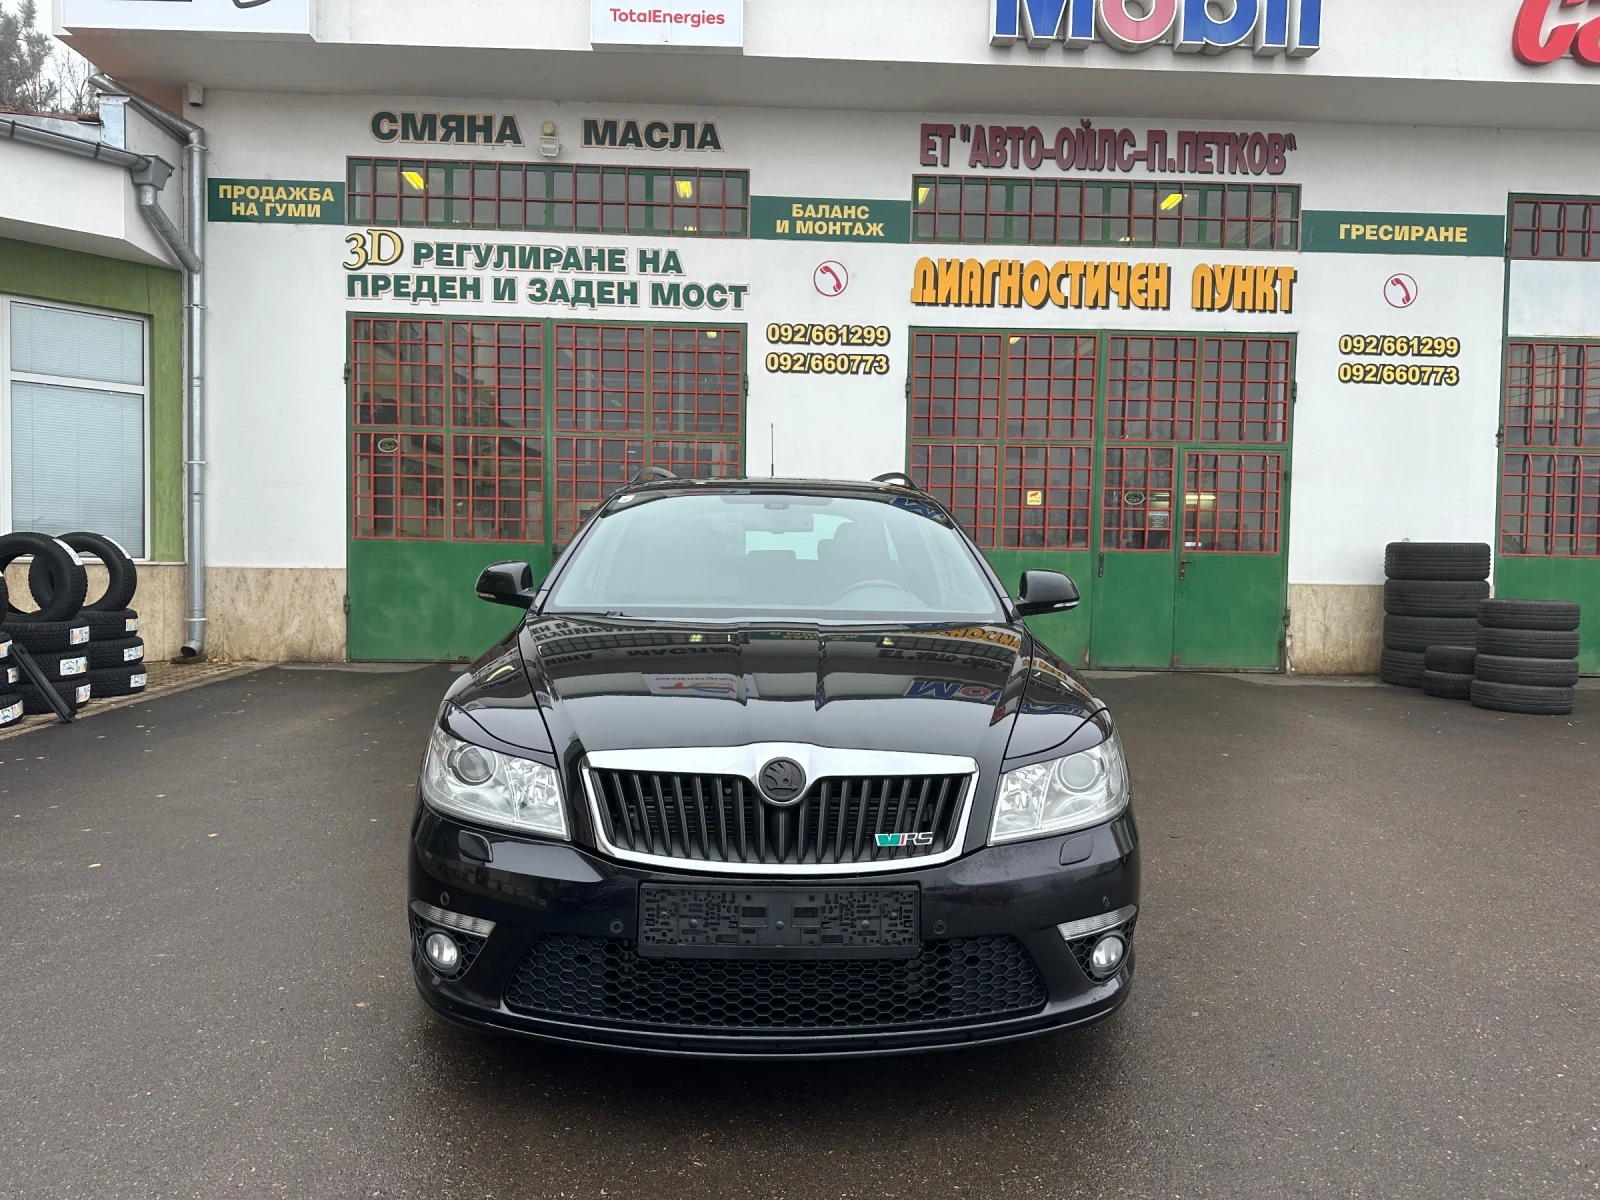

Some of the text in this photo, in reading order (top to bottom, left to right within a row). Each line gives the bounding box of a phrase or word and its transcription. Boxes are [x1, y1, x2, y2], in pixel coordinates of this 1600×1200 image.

[609, 7, 725, 28] TotalEnergies
[370, 110, 724, 152] СМЯНА МАСЛА
[920, 122, 955, 168] ЕТ
[218, 184, 335, 202] ПРОДАЖБА
[231, 201, 321, 218] НА ГУМИ
[791, 203, 870, 220] БАЛАНС
[775, 219, 885, 237] И МОНТАЖ
[1339, 223, 1468, 243] ГРЕСИРАНЕ
[343, 228, 685, 276] 3D РЕГУЛИРАНЕ НА
[345, 273, 750, 311] ПРЕДЕН И ЗАДЕН МОСТ
[910, 256, 1298, 314] ДИАГНОСТИЧЕН ПУНКТ
[766, 323, 891, 347] 092/661299
[1338, 334, 1461, 358] 092/661299
[765, 352, 890, 375] 092/660773
[1338, 362, 1460, 386] 092/660773
